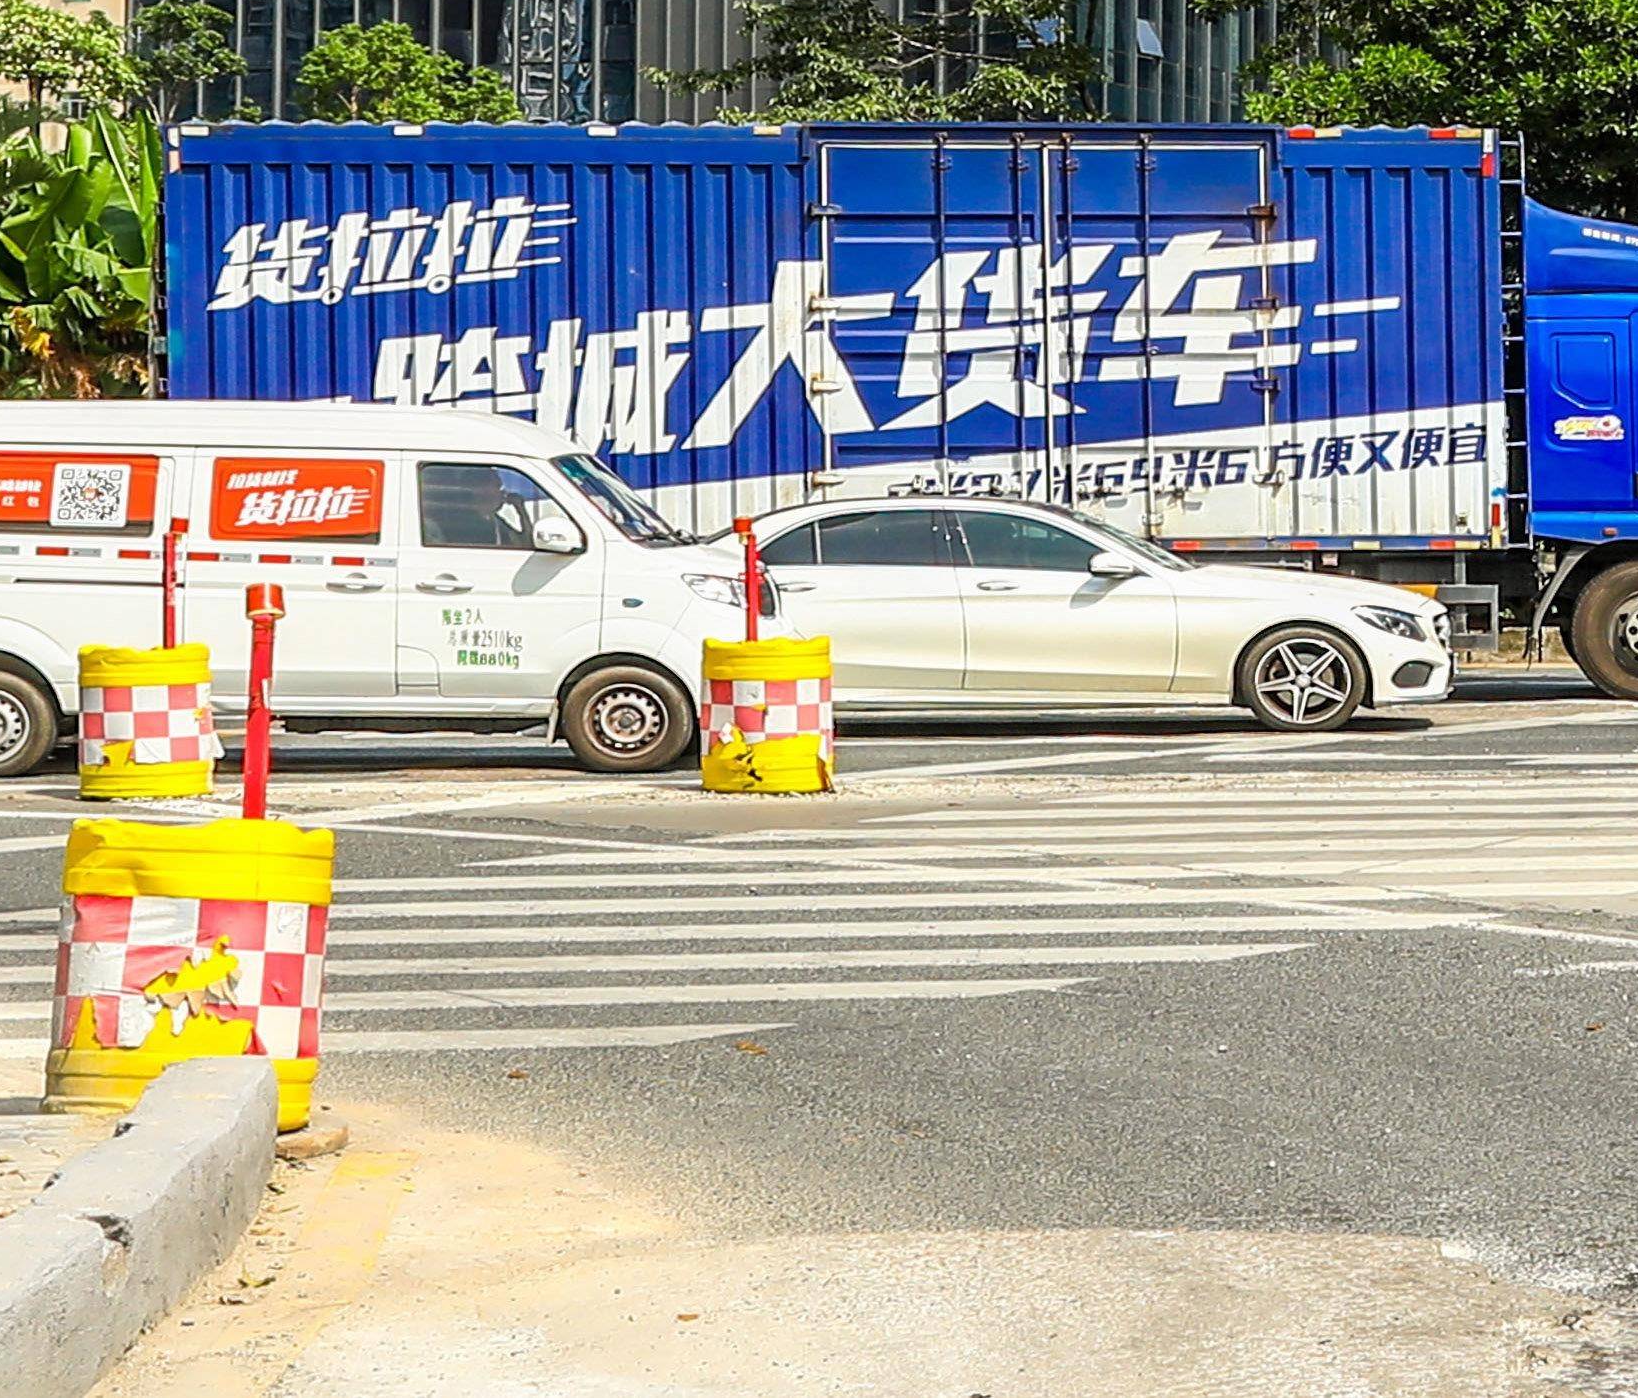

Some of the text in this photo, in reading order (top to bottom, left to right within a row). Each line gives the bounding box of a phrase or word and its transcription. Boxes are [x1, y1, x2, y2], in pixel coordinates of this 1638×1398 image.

[207, 196, 538, 311] 货拉拉
[373, 231, 1319, 456] 跨城大货车
[234, 485, 356, 526] 货拉拉
